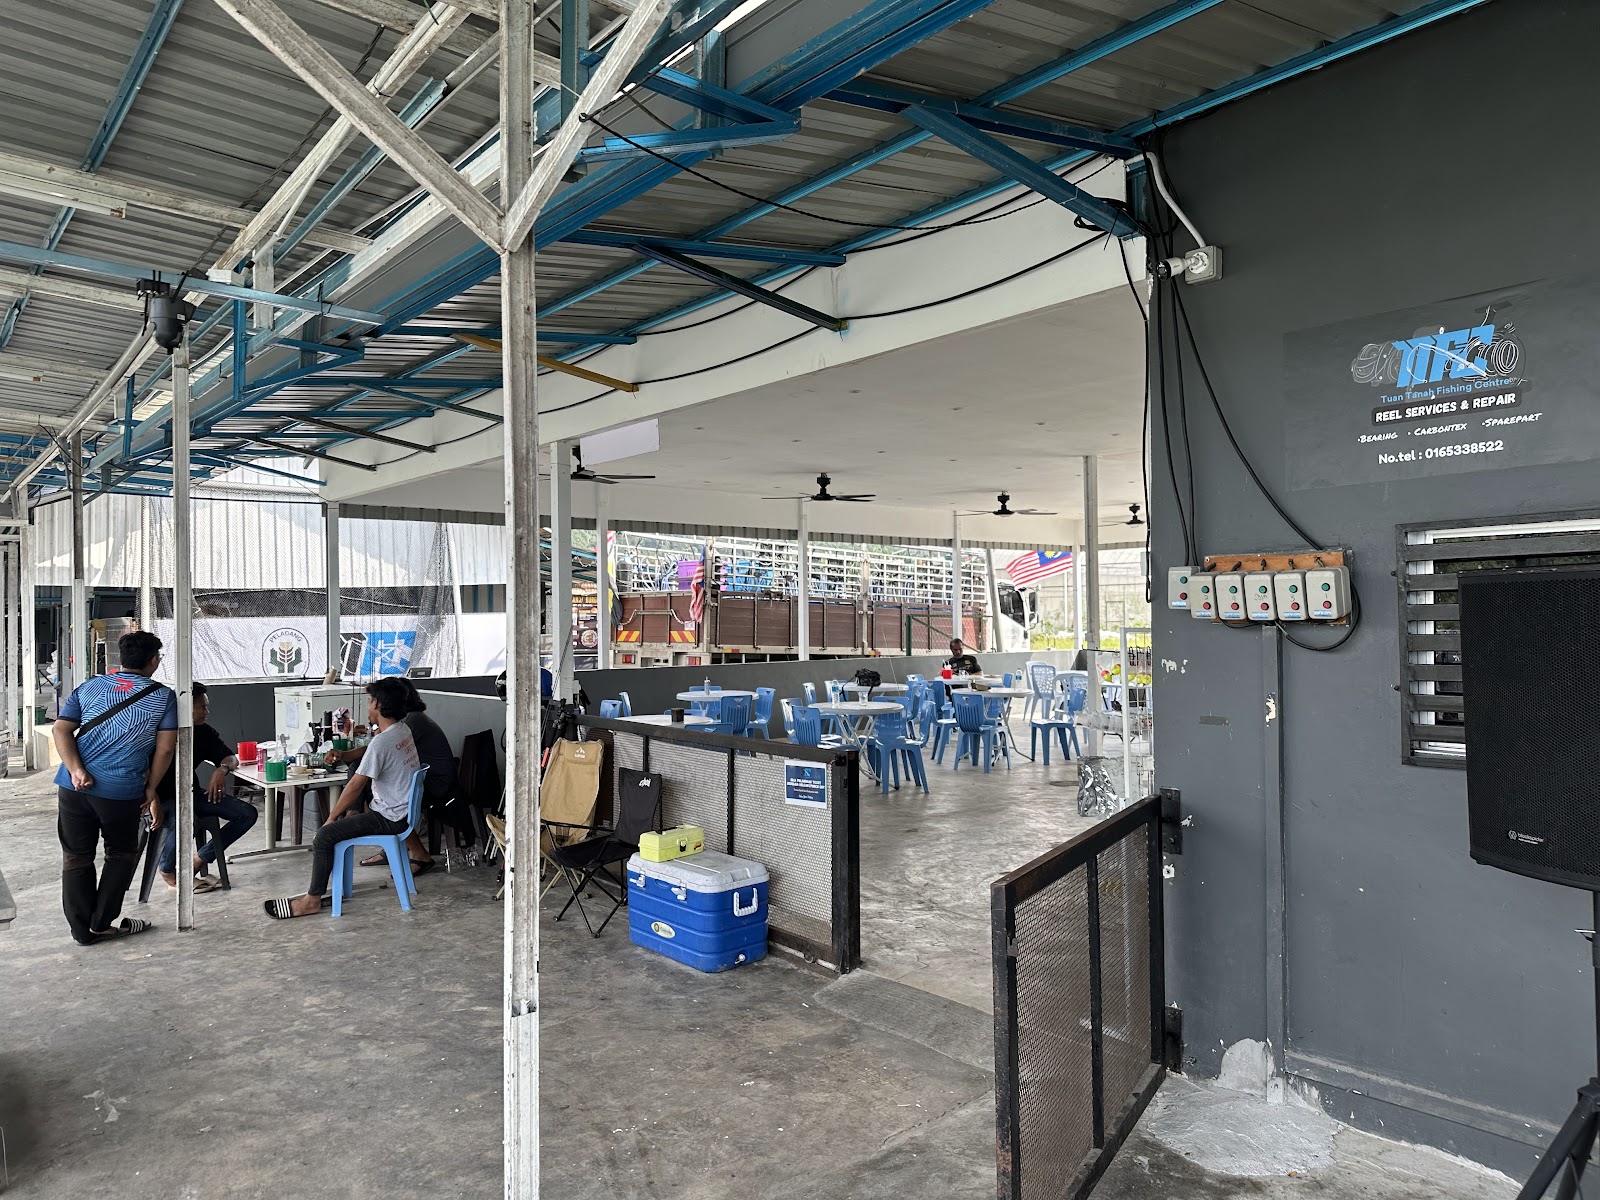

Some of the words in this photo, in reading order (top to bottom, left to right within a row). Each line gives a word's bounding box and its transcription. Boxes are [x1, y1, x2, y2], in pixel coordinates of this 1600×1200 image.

[1380, 394, 1404, 404] Tuan
[1405, 387, 1434, 400] Tanah
[1436, 383, 1472, 395] Fishing
[1474, 378, 1511, 389] Centre
[1375, 409, 1402, 423] REEL
[1405, 401, 1457, 418] SERVICES
[1460, 399, 1470, 411] &
[1472, 392, 1516, 409] REPAIR
[1378, 449, 1416, 464] No.tel
[1424, 440, 1504, 459] 0165338522
[268, 630, 302, 642] PELADANG
